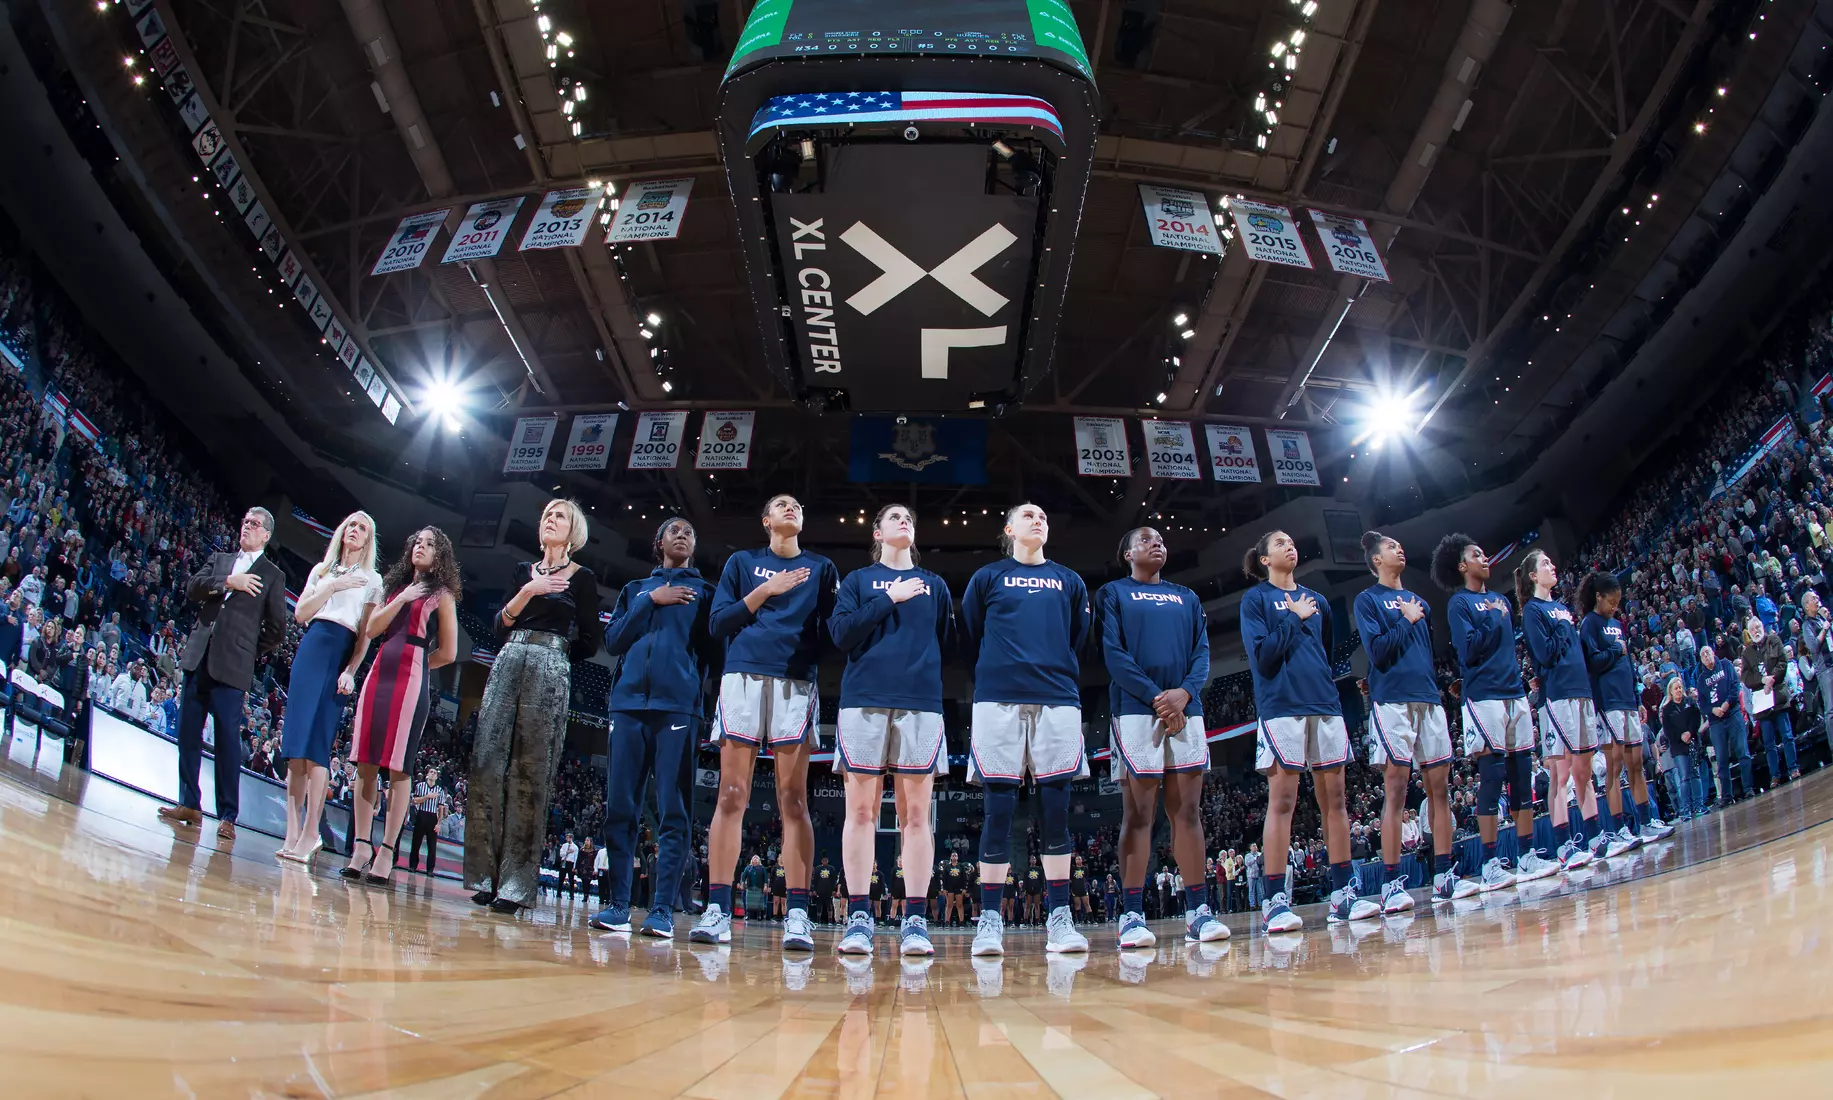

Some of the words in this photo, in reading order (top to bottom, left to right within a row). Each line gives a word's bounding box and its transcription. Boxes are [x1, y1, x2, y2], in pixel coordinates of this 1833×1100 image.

[621, 210, 674, 226] 2014
[533, 219, 583, 234] 2013
[620, 224, 668, 232] NATIONAL
[1157, 219, 1209, 236] 2014
[457, 230, 500, 246] 2011
[532, 232, 574, 241] NATIONAL
[614, 231, 670, 240] CHAMPIONS
[789, 216, 826, 260] XL
[1162, 233, 1211, 244] NATIONAL
[1249, 233, 1297, 250] 2015
[453, 243, 492, 253] NATIONAL
[525, 239, 575, 249] CHAMPIONS
[1160, 239, 1216, 251] CHAMPIONS
[384, 242, 426, 260] 2010
[447, 250, 492, 260] CHAMPIONS
[1255, 246, 1299, 258] NATIONAL
[1332, 244, 1376, 263] 2016
[382, 256, 416, 266] NATIONAL
[1254, 253, 1306, 266] CHAMPIONS
[1338, 258, 1378, 271] NATIONAL
[376, 262, 416, 274] CHAMPIONS
[1338, 265, 1385, 279] CHAMPIONS
[798, 267, 842, 374] CENTER
[512, 447, 544, 458] 1995
[571, 444, 605, 456] 1999
[634, 443, 677, 454] 2000
[702, 443, 746, 454] 2002
[1081, 449, 1125, 461] 2003
[1152, 452, 1194, 464] 2004
[1214, 456, 1255, 468] 2004
[1276, 460, 1314, 472] 2009
[1004, 576, 1063, 591] UCONN
[1131, 592, 1184, 605] UCONN
